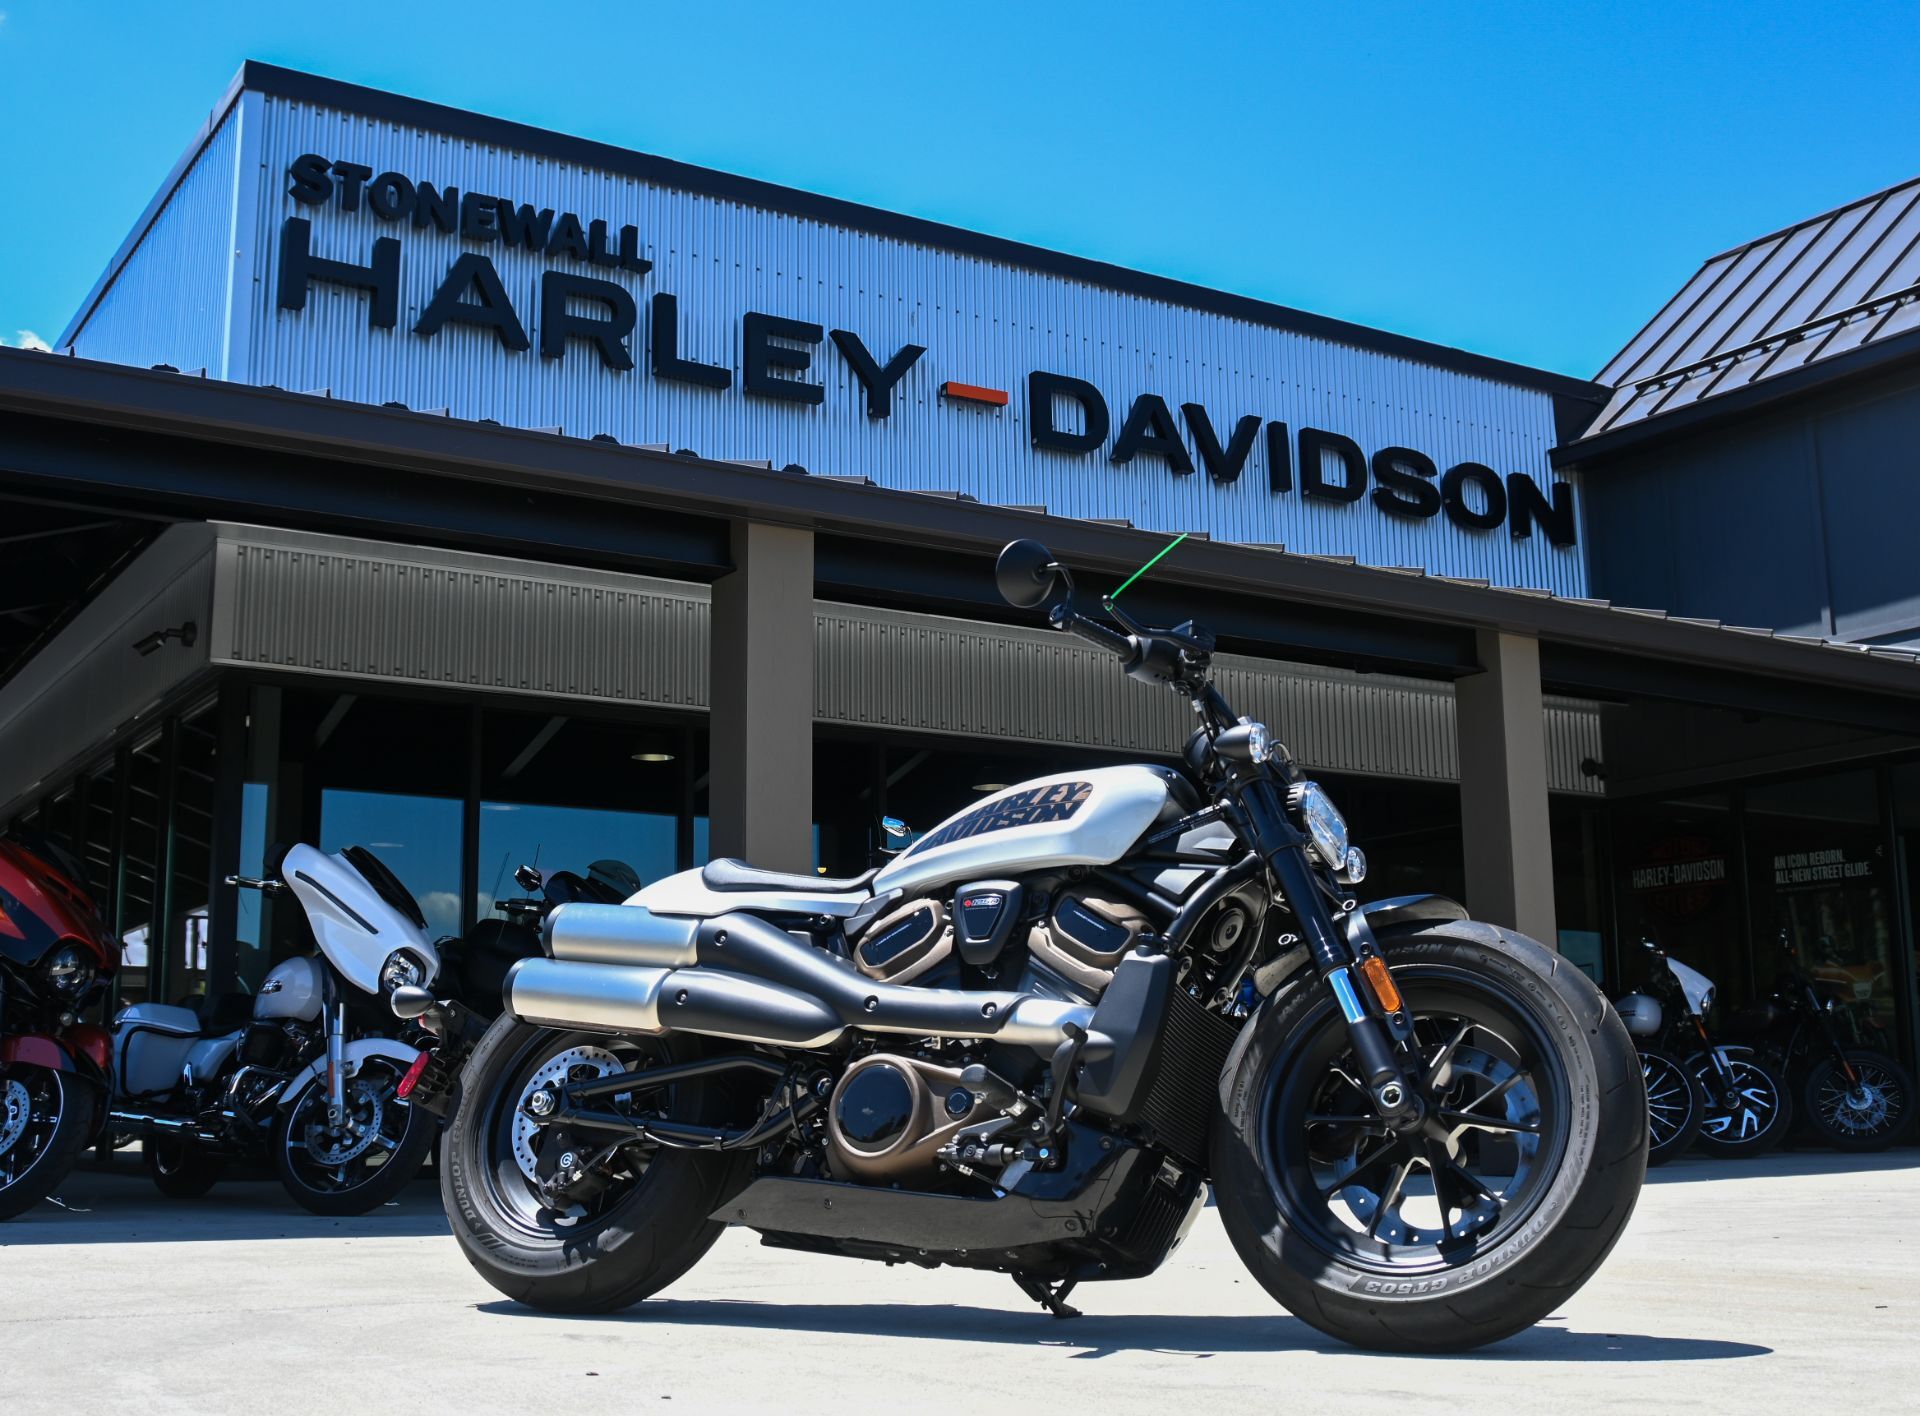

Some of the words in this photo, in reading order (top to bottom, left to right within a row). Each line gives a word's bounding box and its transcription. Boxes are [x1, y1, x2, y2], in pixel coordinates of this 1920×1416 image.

[289, 154, 653, 274] STONEWALL
[1632, 859, 1725, 889] HARLEY-DAVIDSON
[1774, 856, 1787, 870] AN
[1787, 852, 1808, 868] ICON
[1775, 867, 1812, 884] ALL-NEW
[1812, 863, 1844, 880] STREET
[451, 1151, 477, 1221] DUNLOP
[1457, 1214, 1549, 1285] DUNLOP
[1364, 1277, 1448, 1295] GT503
